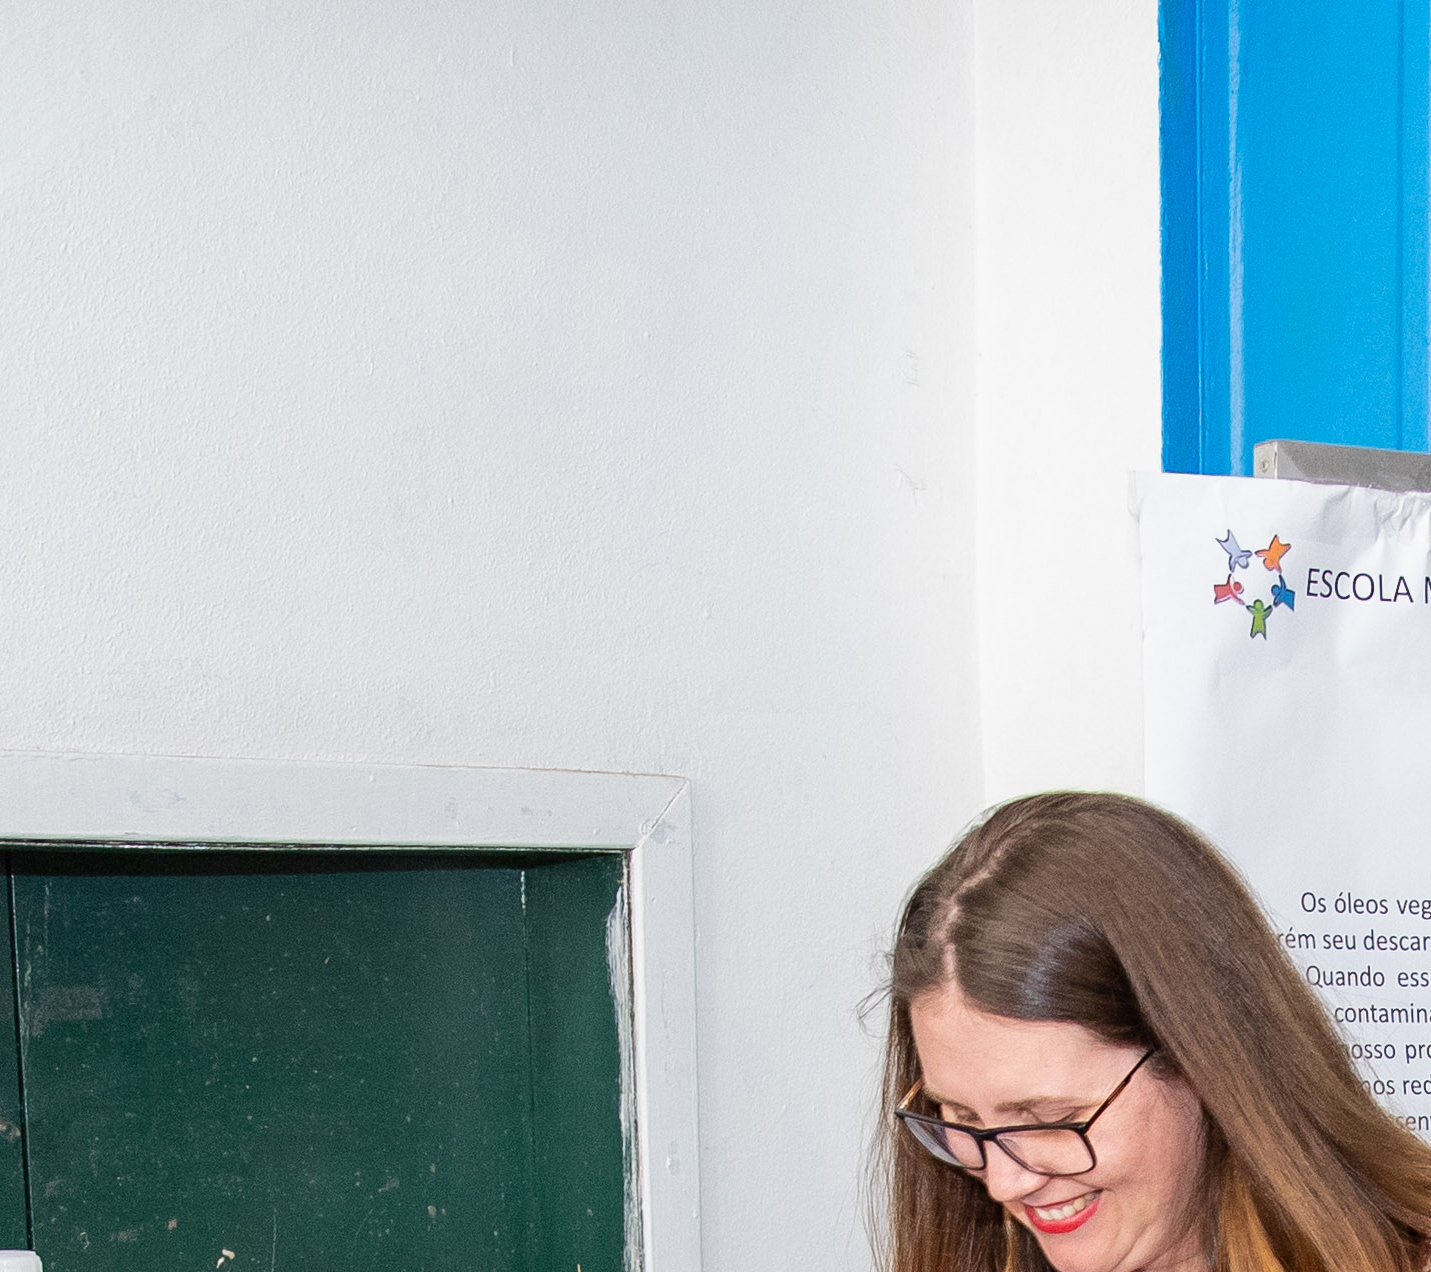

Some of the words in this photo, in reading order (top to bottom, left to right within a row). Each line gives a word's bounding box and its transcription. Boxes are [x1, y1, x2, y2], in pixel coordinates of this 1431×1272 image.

[1306, 567, 1415, 604] ESCOLA
[1300, 891, 1327, 914] Os
[1333, 891, 1389, 915] óleos
[1322, 933, 1357, 951] seu
[1306, 964, 1386, 988] Quando
